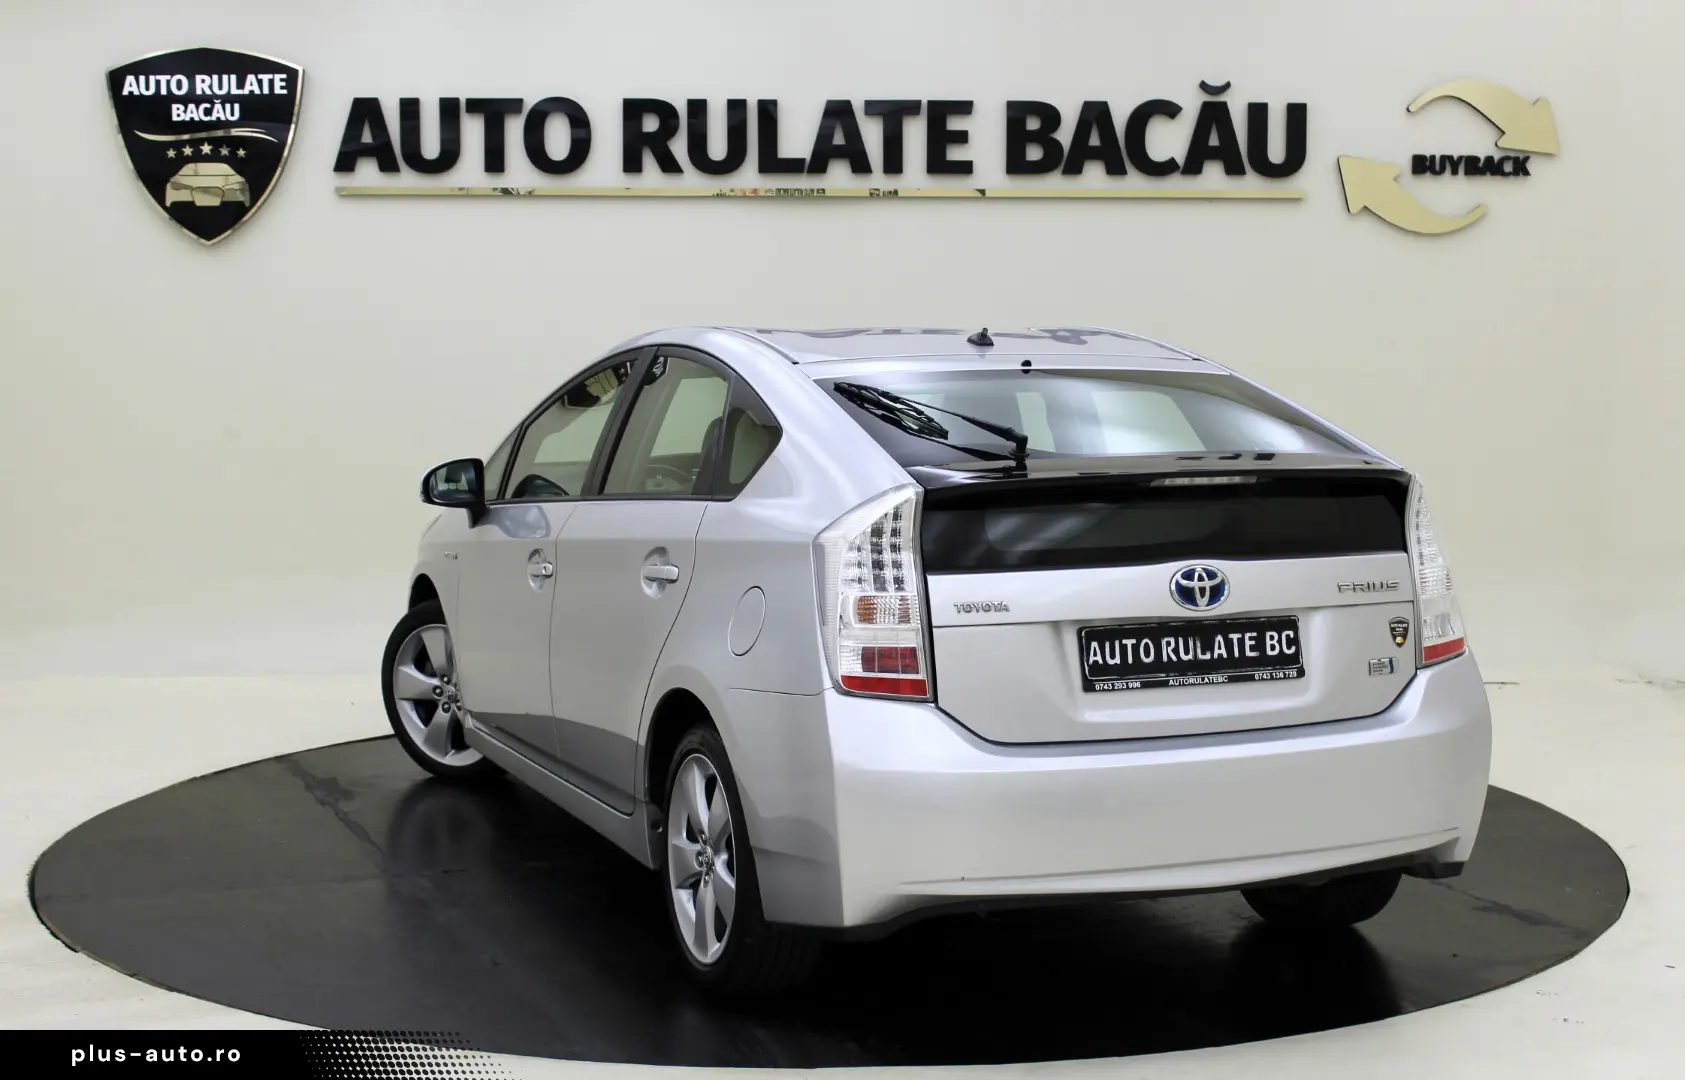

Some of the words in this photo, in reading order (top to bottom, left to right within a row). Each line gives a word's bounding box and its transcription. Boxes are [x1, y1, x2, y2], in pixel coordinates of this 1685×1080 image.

[122, 75, 189, 96] AUTO
[195, 74, 288, 95] RULATE
[171, 99, 240, 122] BACĂU
[333, 96, 592, 175] AUTO
[622, 98, 973, 176] RULATE
[1005, 80, 1307, 179] BACĂU
[1411, 154, 1531, 177] BUYBACK
[1337, 581, 1400, 593] PRIUS
[953, 600, 1010, 614] TOYOTA
[1088, 638, 1155, 665] AUTO
[1160, 632, 1260, 662] RULATE
[1265, 630, 1296, 656] BC
[1168, 676, 1229, 686] AUTORULATEBC
[1254, 672, 1271, 680] 0743
[1095, 683, 1113, 691] 0743
[1114, 682, 1127, 690] 293
[1128, 681, 1141, 689] 996
